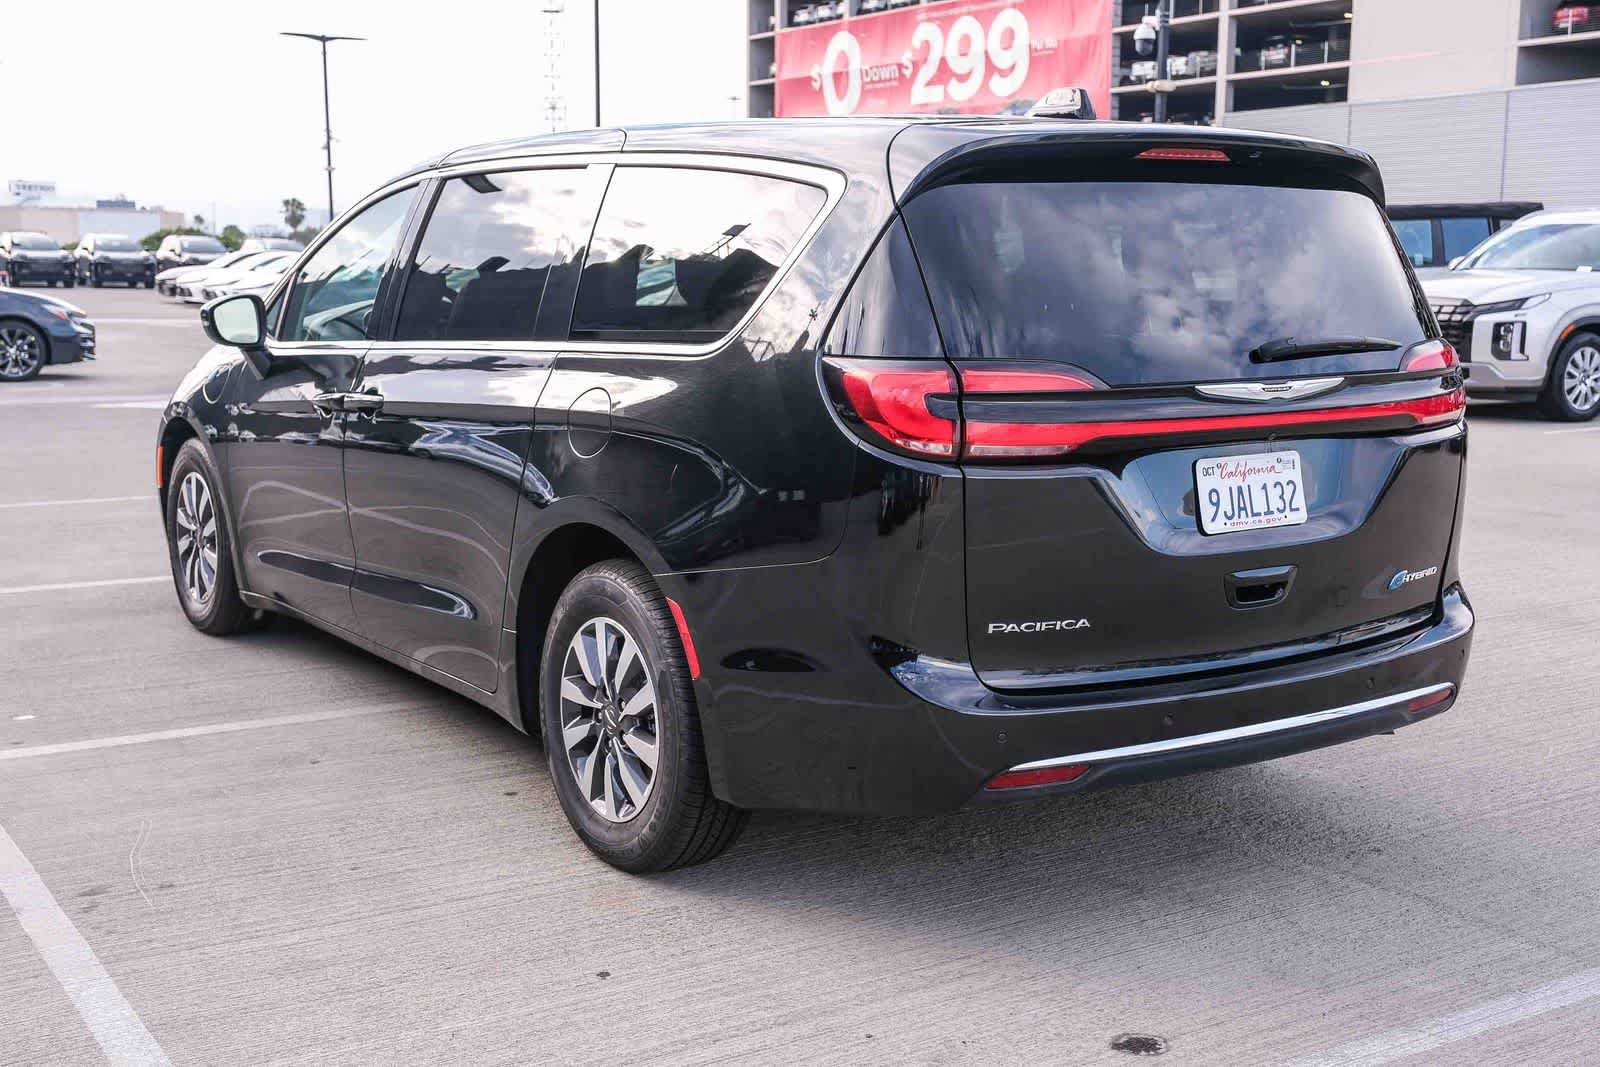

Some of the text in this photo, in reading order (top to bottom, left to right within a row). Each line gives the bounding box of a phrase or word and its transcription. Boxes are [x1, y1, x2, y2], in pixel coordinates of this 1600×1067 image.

[862, 64, 899, 82] Down
[901, 8, 1030, 105] $299
[1202, 465, 1215, 477] OCT
[1219, 460, 1282, 482] California
[1208, 479, 1300, 522] 9JAL132
[987, 618, 1091, 634] PACIFICA
